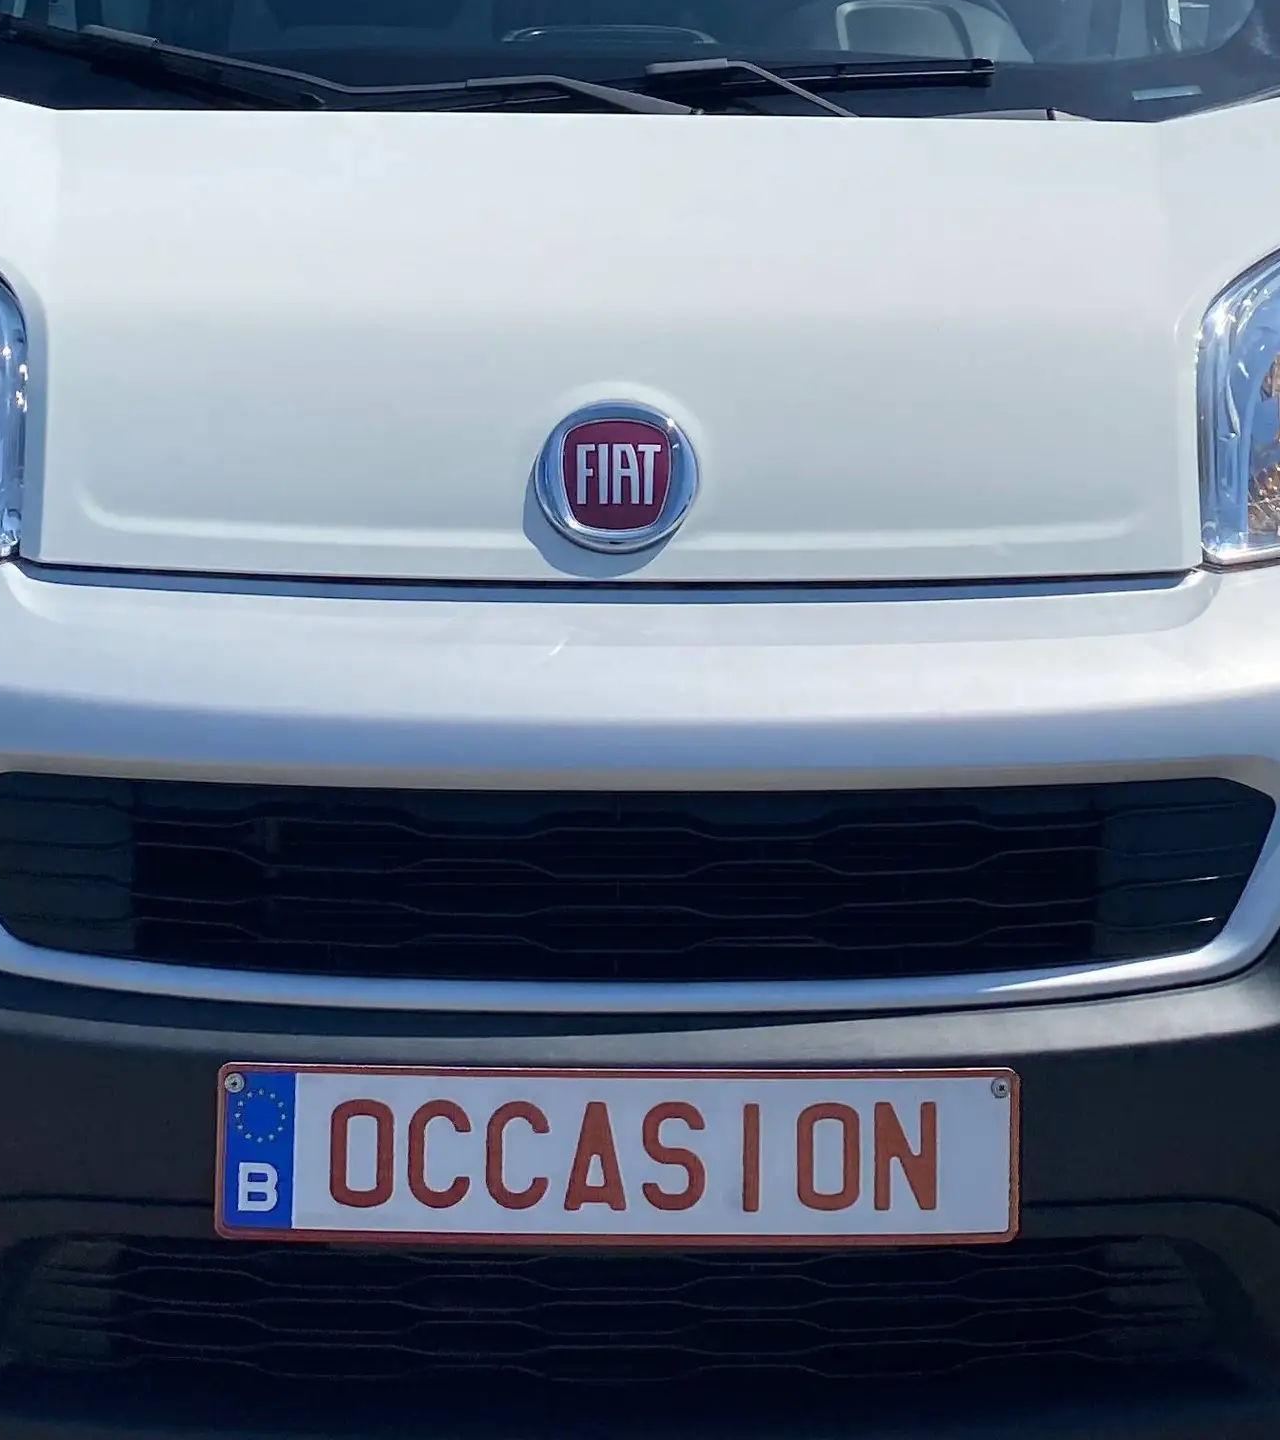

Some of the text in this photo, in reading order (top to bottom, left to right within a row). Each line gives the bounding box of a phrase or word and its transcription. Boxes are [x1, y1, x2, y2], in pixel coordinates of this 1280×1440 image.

[576, 443, 662, 505] FIAT
[328, 1098, 937, 1213] OCCASION
[236, 1162, 279, 1212] B
